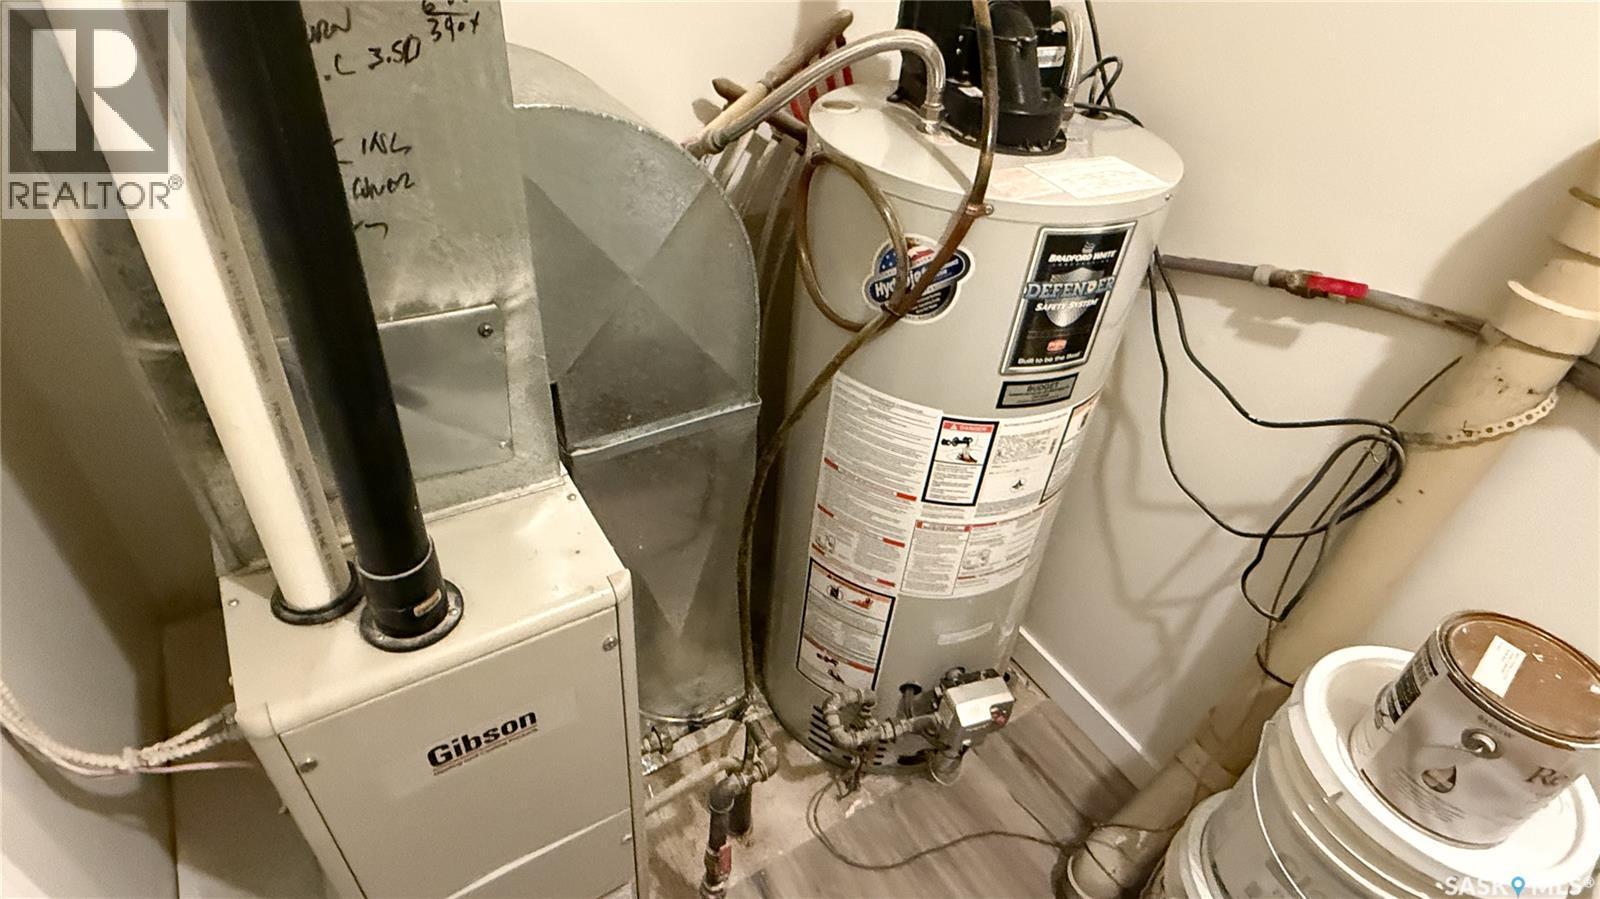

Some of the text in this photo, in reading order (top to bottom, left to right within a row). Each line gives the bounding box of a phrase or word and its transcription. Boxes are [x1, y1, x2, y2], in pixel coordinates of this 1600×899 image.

[1048, 254, 1093, 263] BRADFORD
[1024, 276, 1116, 299] DEFENDER
[1035, 298, 1099, 312] SAFETY SYSTEM
[427, 711, 537, 768] Gibson
